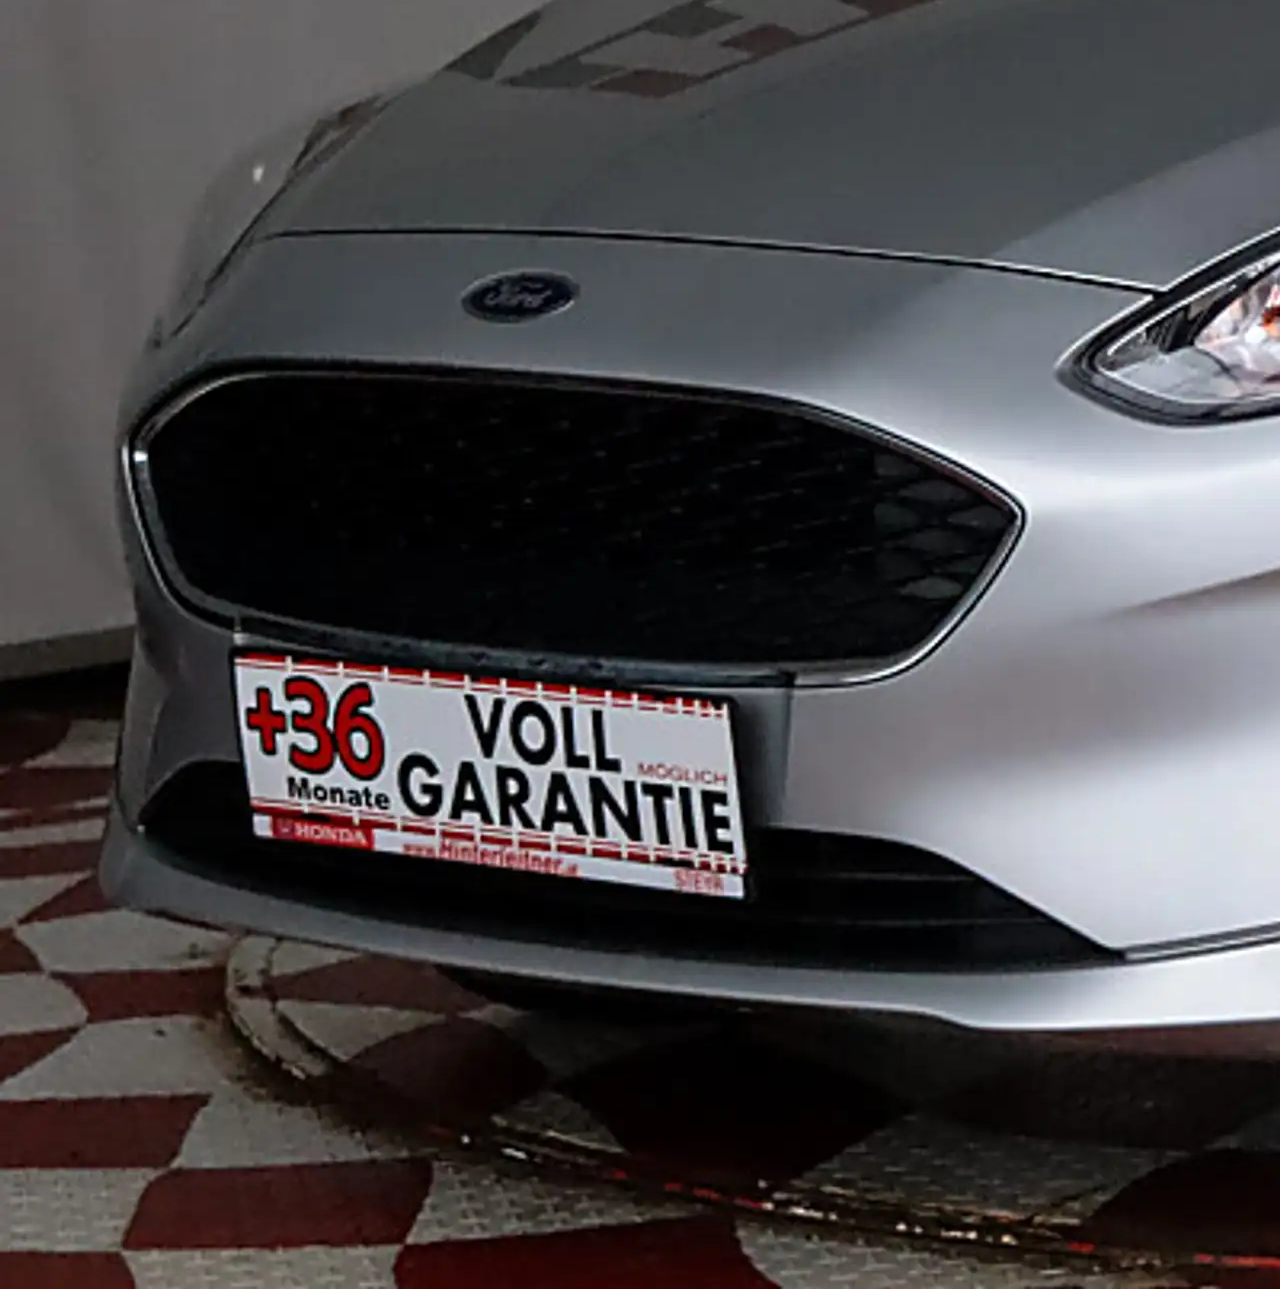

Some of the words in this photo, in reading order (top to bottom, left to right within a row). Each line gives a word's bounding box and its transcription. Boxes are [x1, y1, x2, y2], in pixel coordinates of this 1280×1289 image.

[246, 675, 385, 781] +36
[463, 694, 622, 773] VOLL
[287, 776, 391, 811] Monate
[397, 752, 734, 855] GARANTIE
[293, 821, 368, 847] HONDA
